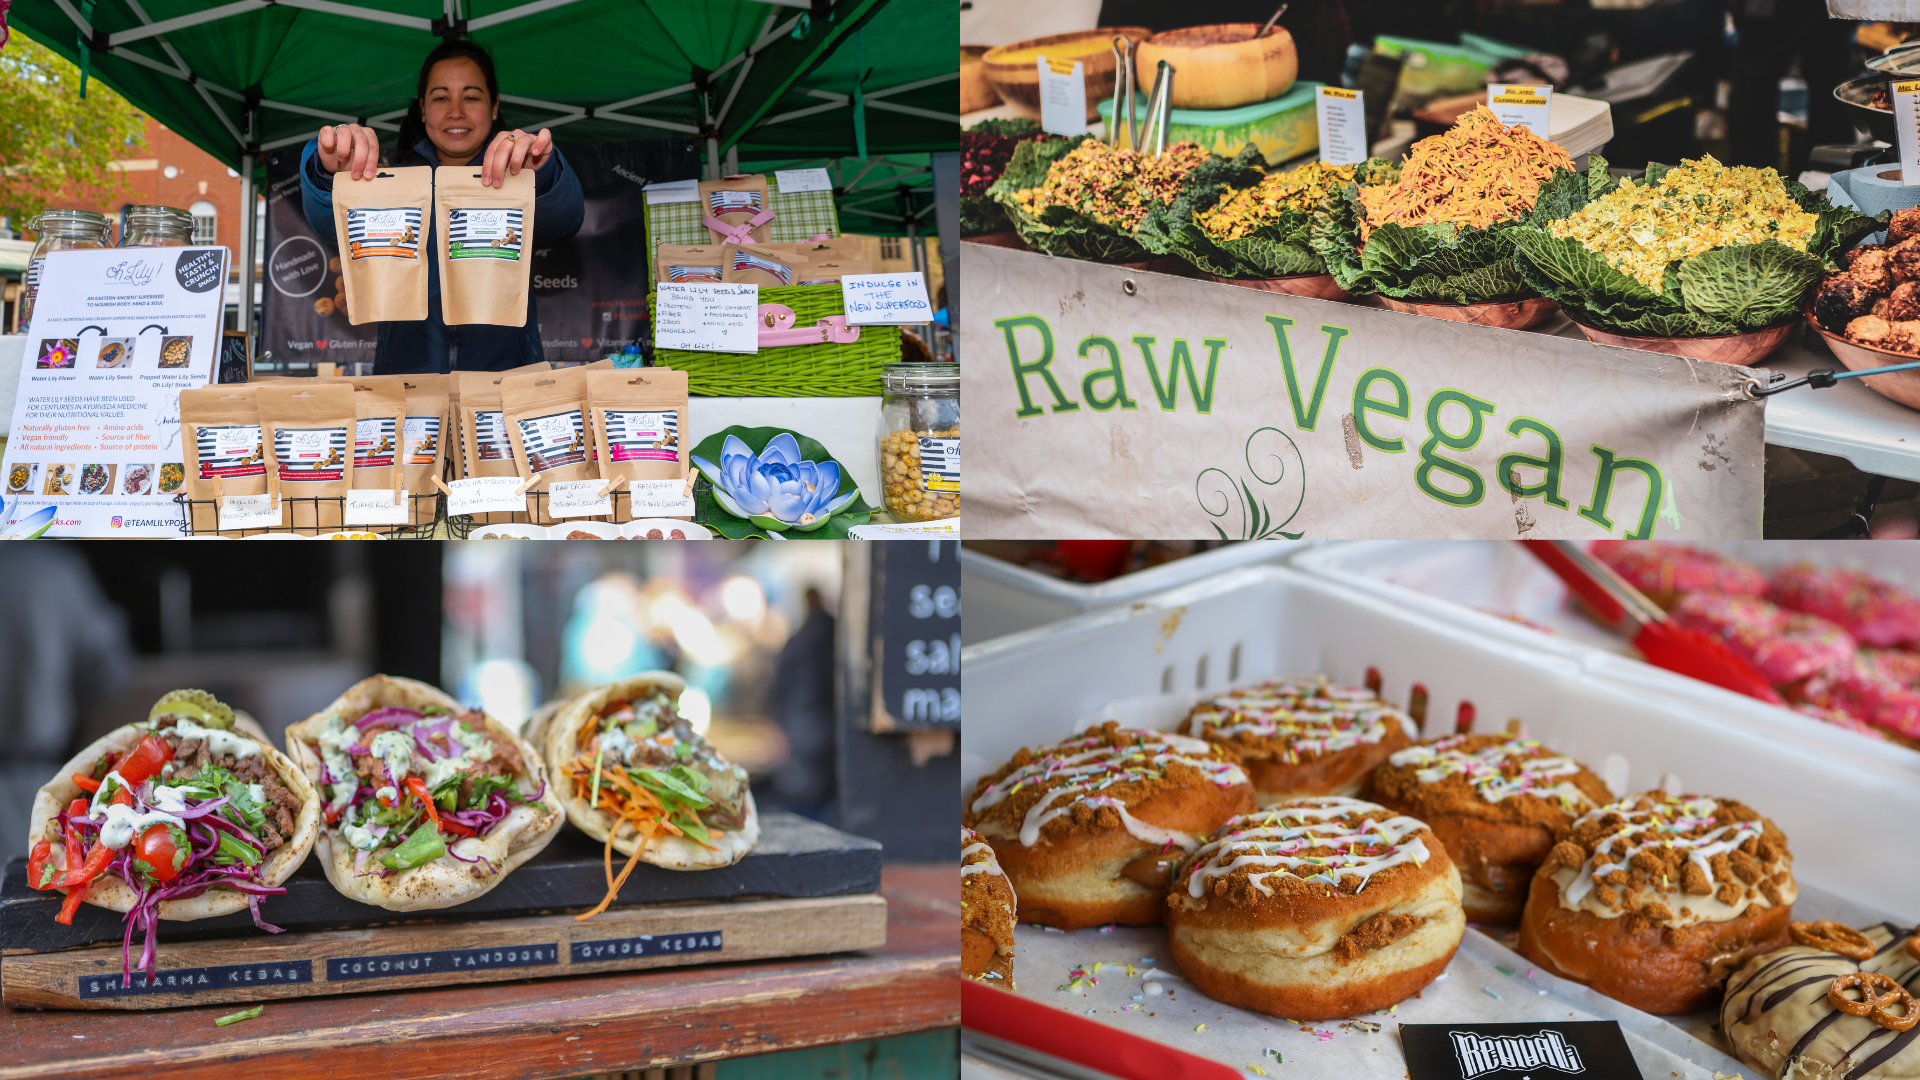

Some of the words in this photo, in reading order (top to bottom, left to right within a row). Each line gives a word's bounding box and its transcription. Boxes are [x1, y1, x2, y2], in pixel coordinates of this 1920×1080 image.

[275, 250, 316, 272] Handmade
[184, 262, 207, 279] TASTY
[184, 263, 220, 287] CRUNCHY
[282, 270, 300, 283] with
[301, 262, 319, 276] Love
[198, 275, 217, 288] SNACK
[533, 274, 578, 289] Seeds
[849, 280, 902, 289] INDULGE
[864, 290, 893, 299] THE
[849, 300, 871, 313] NEW
[875, 300, 927, 310] SUPERFOOD
[287, 340, 313, 350] Vegan
[329, 339, 357, 349] Gluten
[359, 339, 377, 348] Free
[993, 313, 1227, 420] Raw
[1262, 312, 1666, 540] Vegan
[22, 434, 42, 442] Vegan
[133, 443, 158, 451] protein
[582, 942, 644, 958] GYROS
[660, 934, 722, 950] KEBAB
[340, 957, 433, 974] COCONUT
[453, 948, 555, 968] TANDOORI
[228, 968, 298, 982] KEBAB
